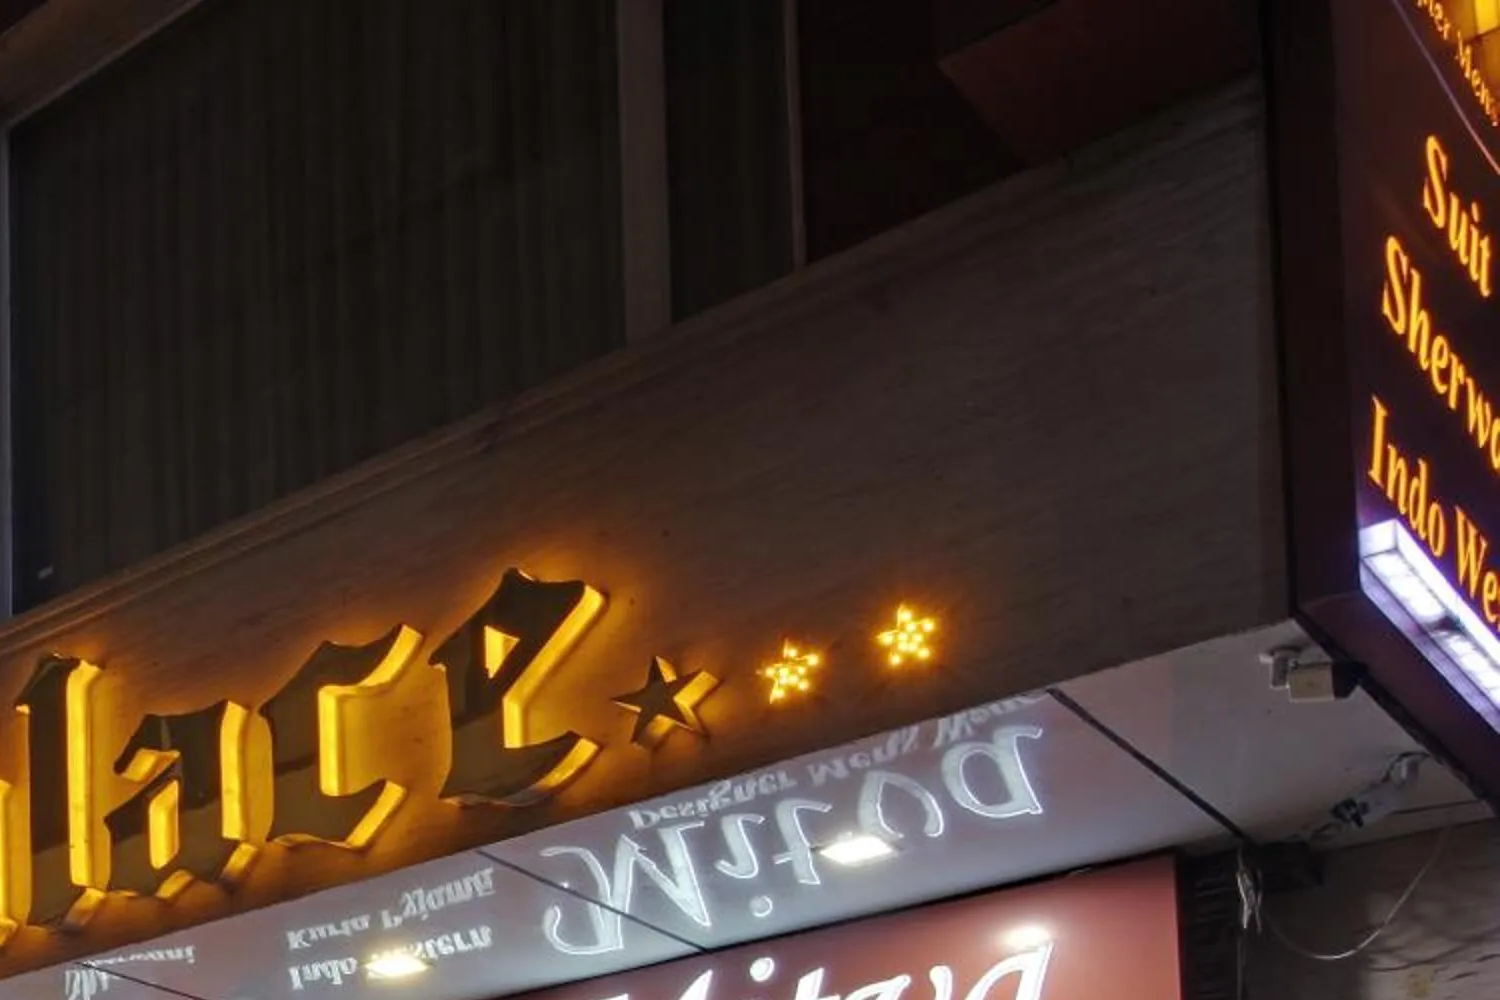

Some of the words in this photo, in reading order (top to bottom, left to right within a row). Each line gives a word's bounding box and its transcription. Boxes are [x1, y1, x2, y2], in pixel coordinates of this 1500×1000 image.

[1423, 134, 1492, 298] Suit
[1367, 393, 1446, 558] Indo
[1454, 504, 1500, 636] We
